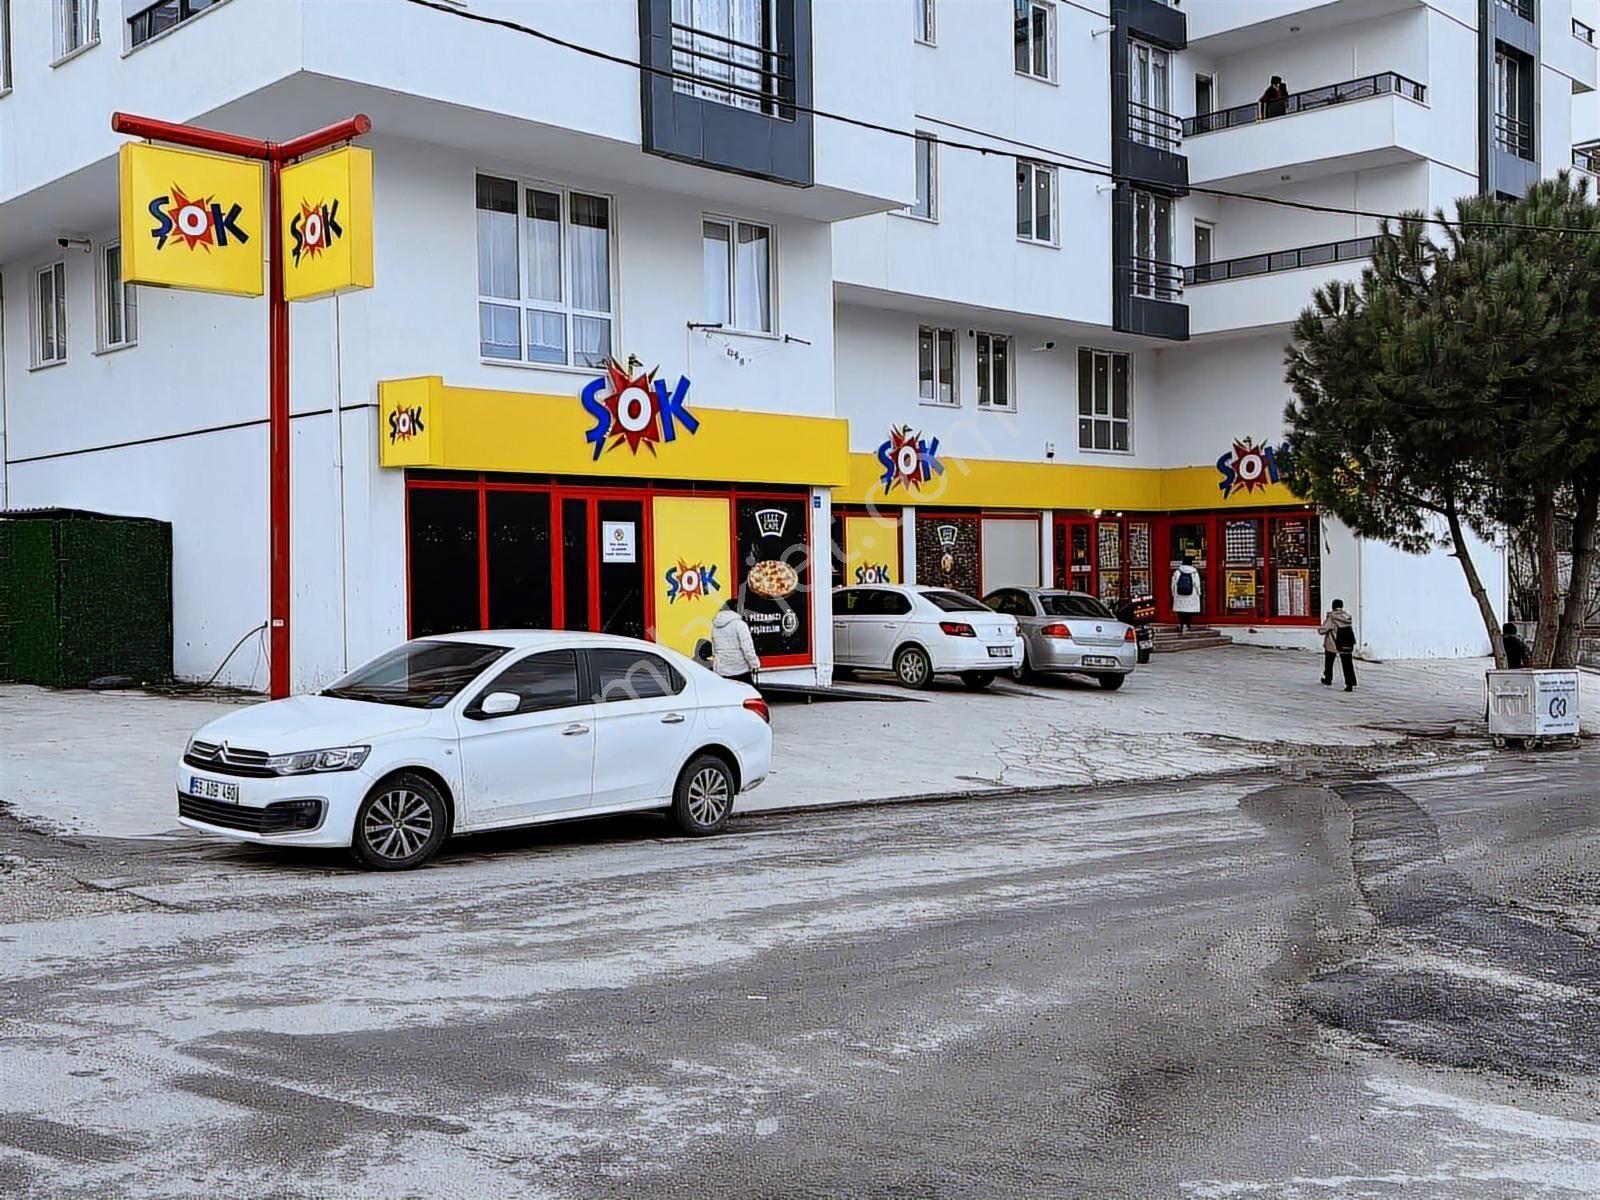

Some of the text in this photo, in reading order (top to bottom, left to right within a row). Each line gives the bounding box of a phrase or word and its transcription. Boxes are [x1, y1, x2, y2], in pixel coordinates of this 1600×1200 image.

[148, 196, 249, 251] ŞOK
[290, 199, 343, 267] ŞOK
[388, 405, 424, 445] ŞOK
[581, 375, 700, 461] ŞOK
[878, 436, 945, 496] ŞOK
[665, 564, 721, 605] ŞOK
